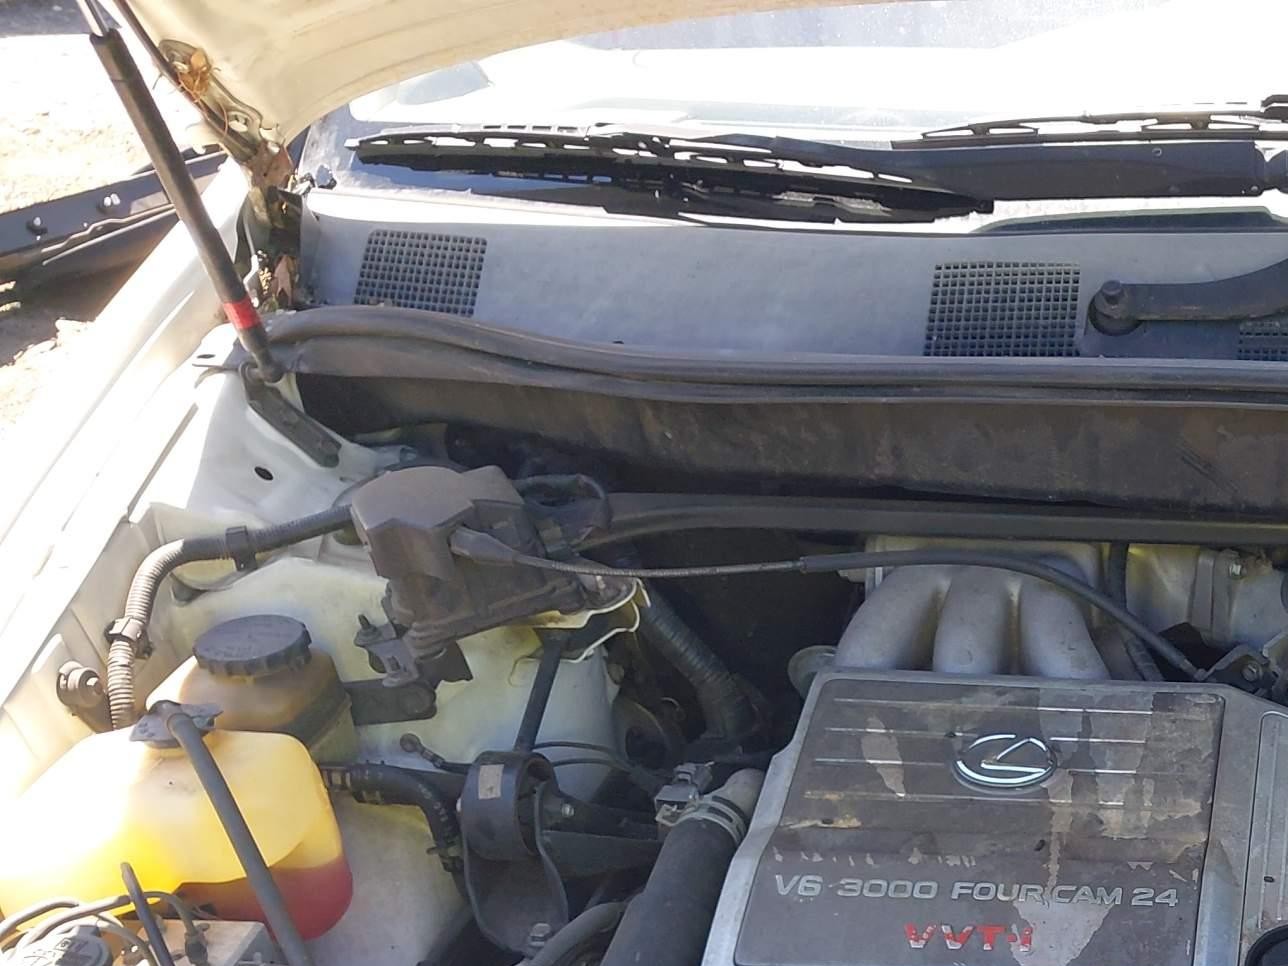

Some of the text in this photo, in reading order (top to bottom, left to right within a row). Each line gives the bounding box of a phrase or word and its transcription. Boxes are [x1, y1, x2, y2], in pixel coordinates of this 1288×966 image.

[775, 874, 1179, 907] V6 3000 FOUR CAM 24
